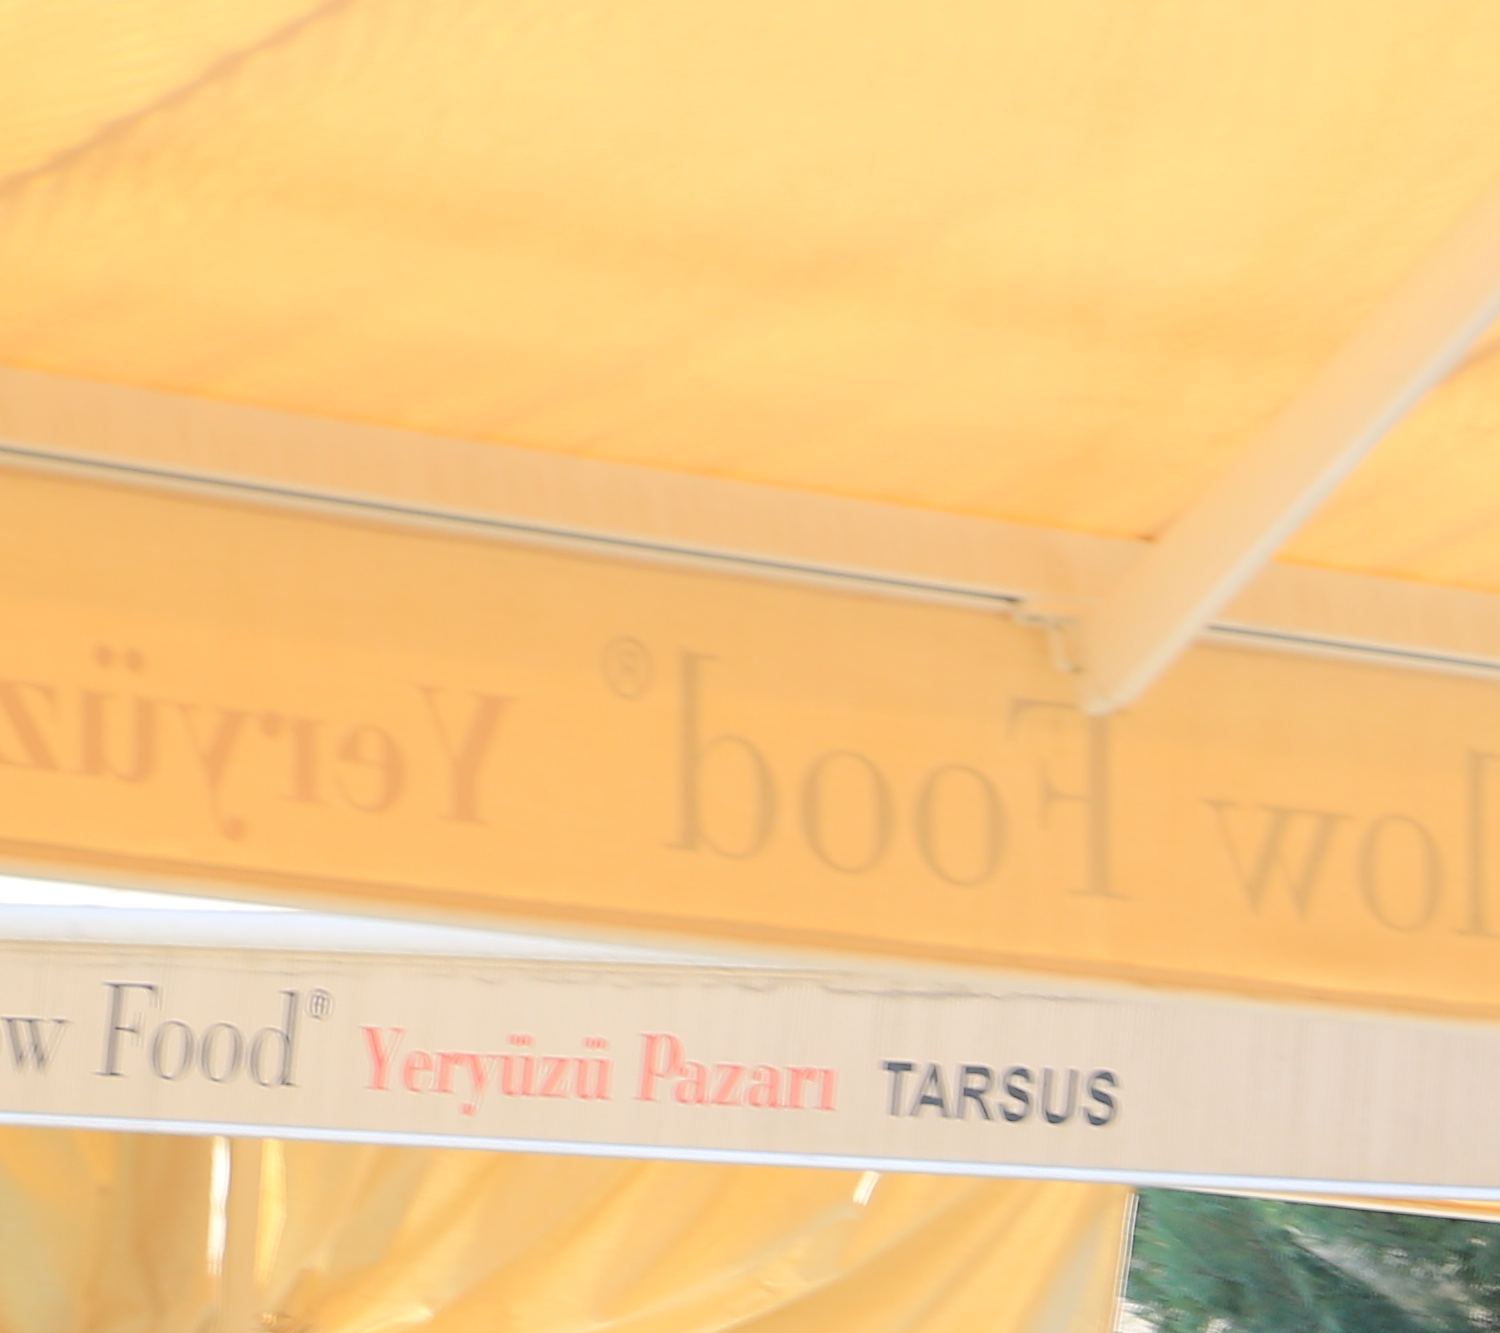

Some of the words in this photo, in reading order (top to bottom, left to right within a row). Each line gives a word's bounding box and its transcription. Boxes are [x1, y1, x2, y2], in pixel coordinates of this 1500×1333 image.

[361, 1025, 612, 1115] Yeryüzü
[633, 1030, 839, 1113] Pazarı
[881, 1058, 1121, 1128] TARSUS
